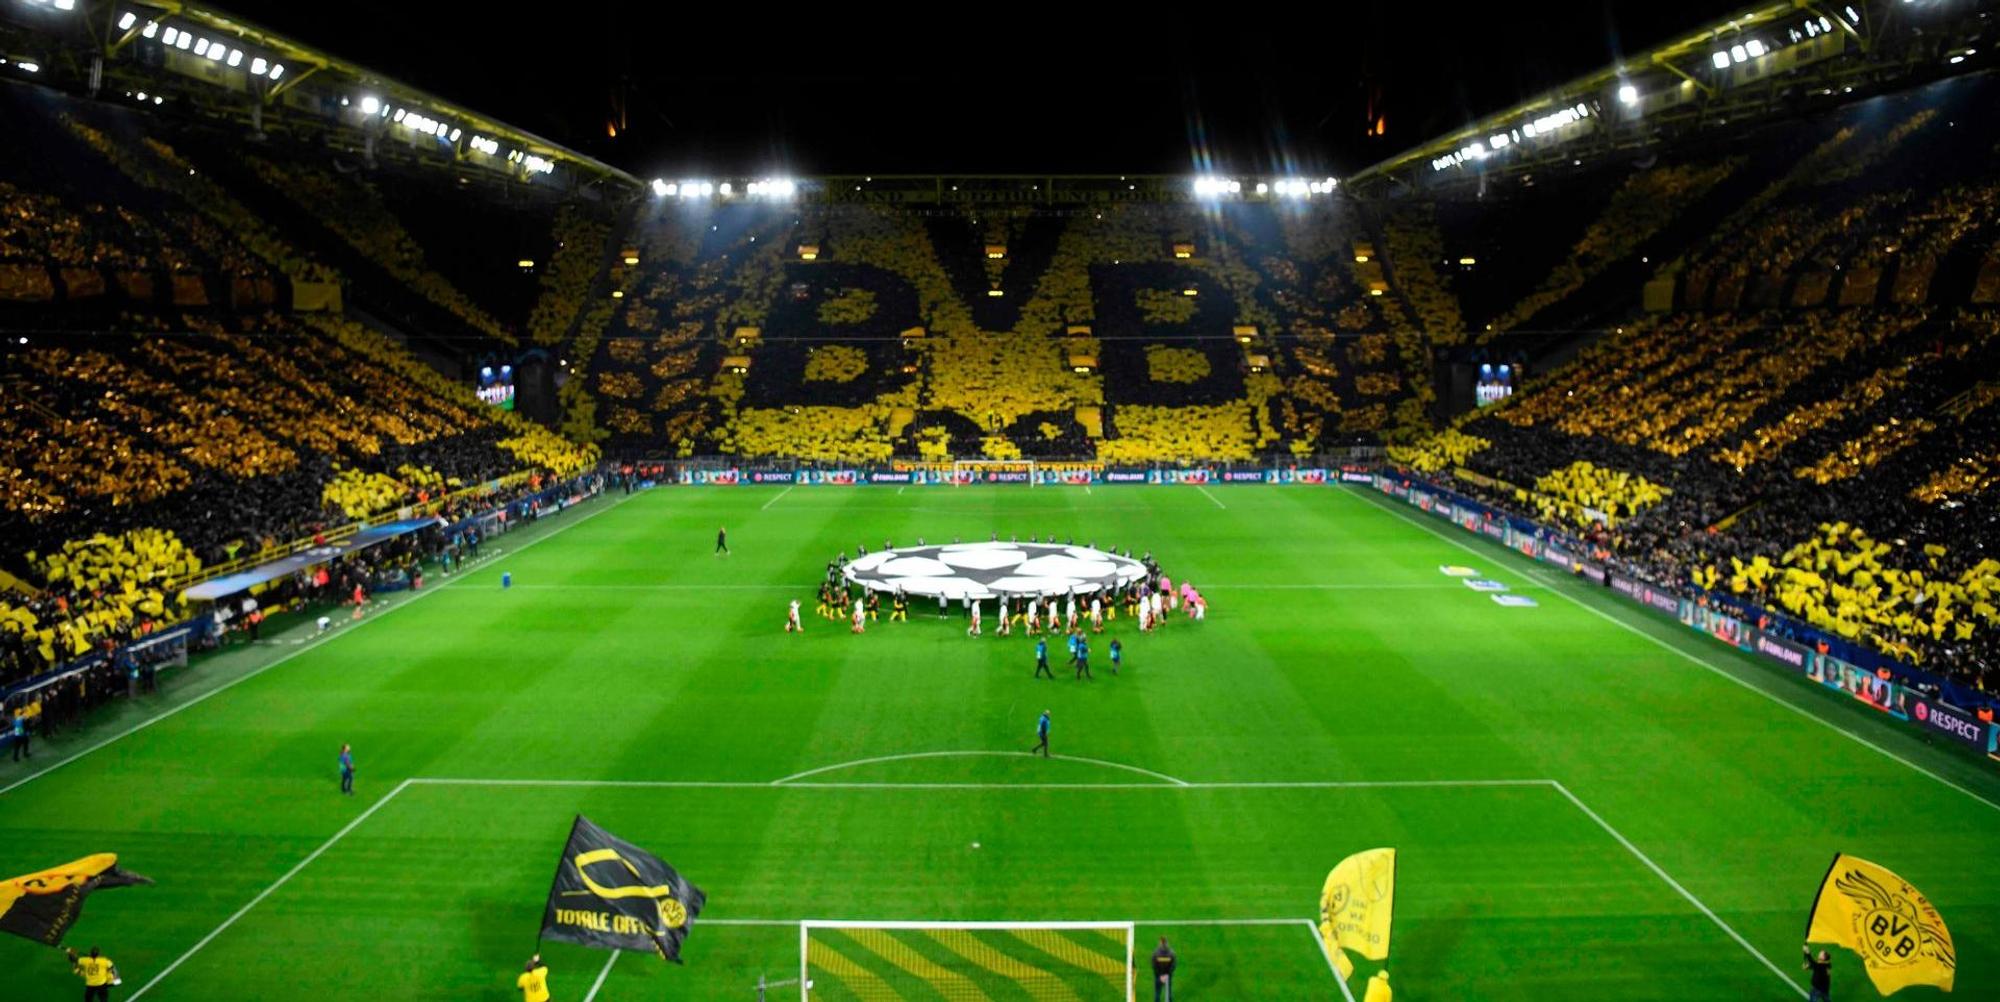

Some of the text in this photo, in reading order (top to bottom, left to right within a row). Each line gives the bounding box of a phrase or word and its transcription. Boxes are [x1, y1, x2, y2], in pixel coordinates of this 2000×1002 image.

[1930, 708, 1981, 741] RESPECT
[1870, 914, 1915, 958] BVB
[1875, 939, 1892, 957] 09
